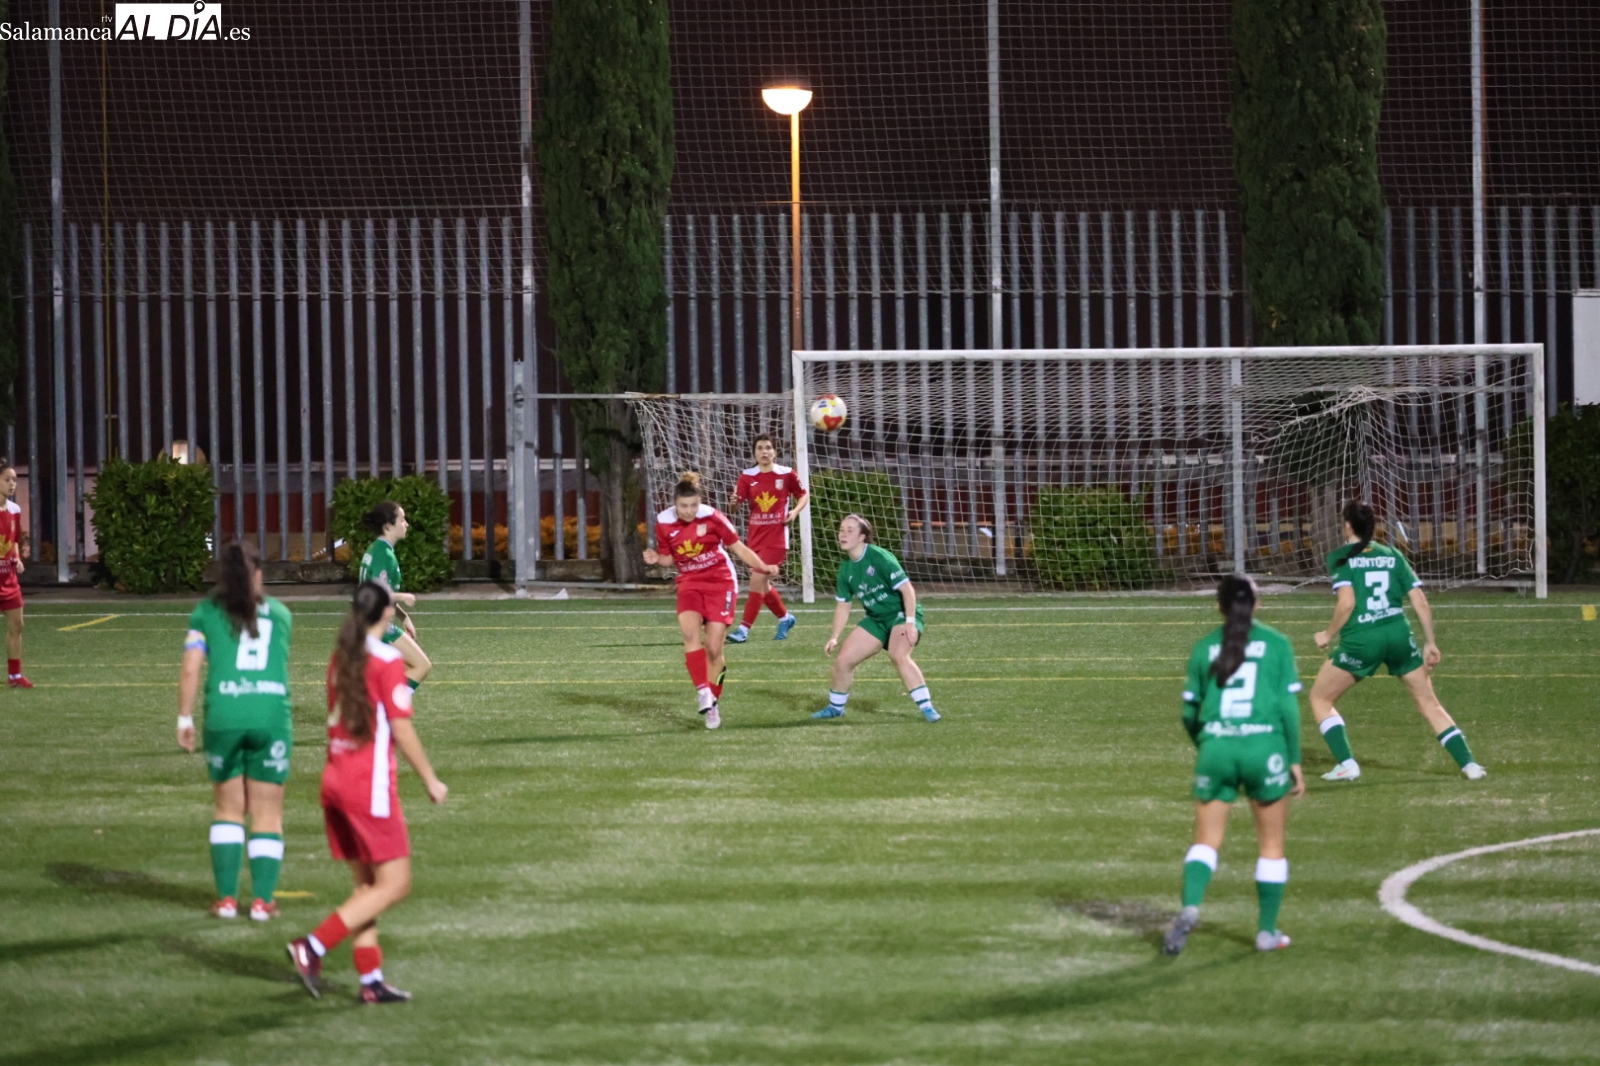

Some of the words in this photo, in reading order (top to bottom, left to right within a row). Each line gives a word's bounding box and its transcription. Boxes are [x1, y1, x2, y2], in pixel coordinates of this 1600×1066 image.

[1365, 571, 1390, 610] 3
[236, 618, 273, 670] 8
[1220, 661, 1258, 719] 2
